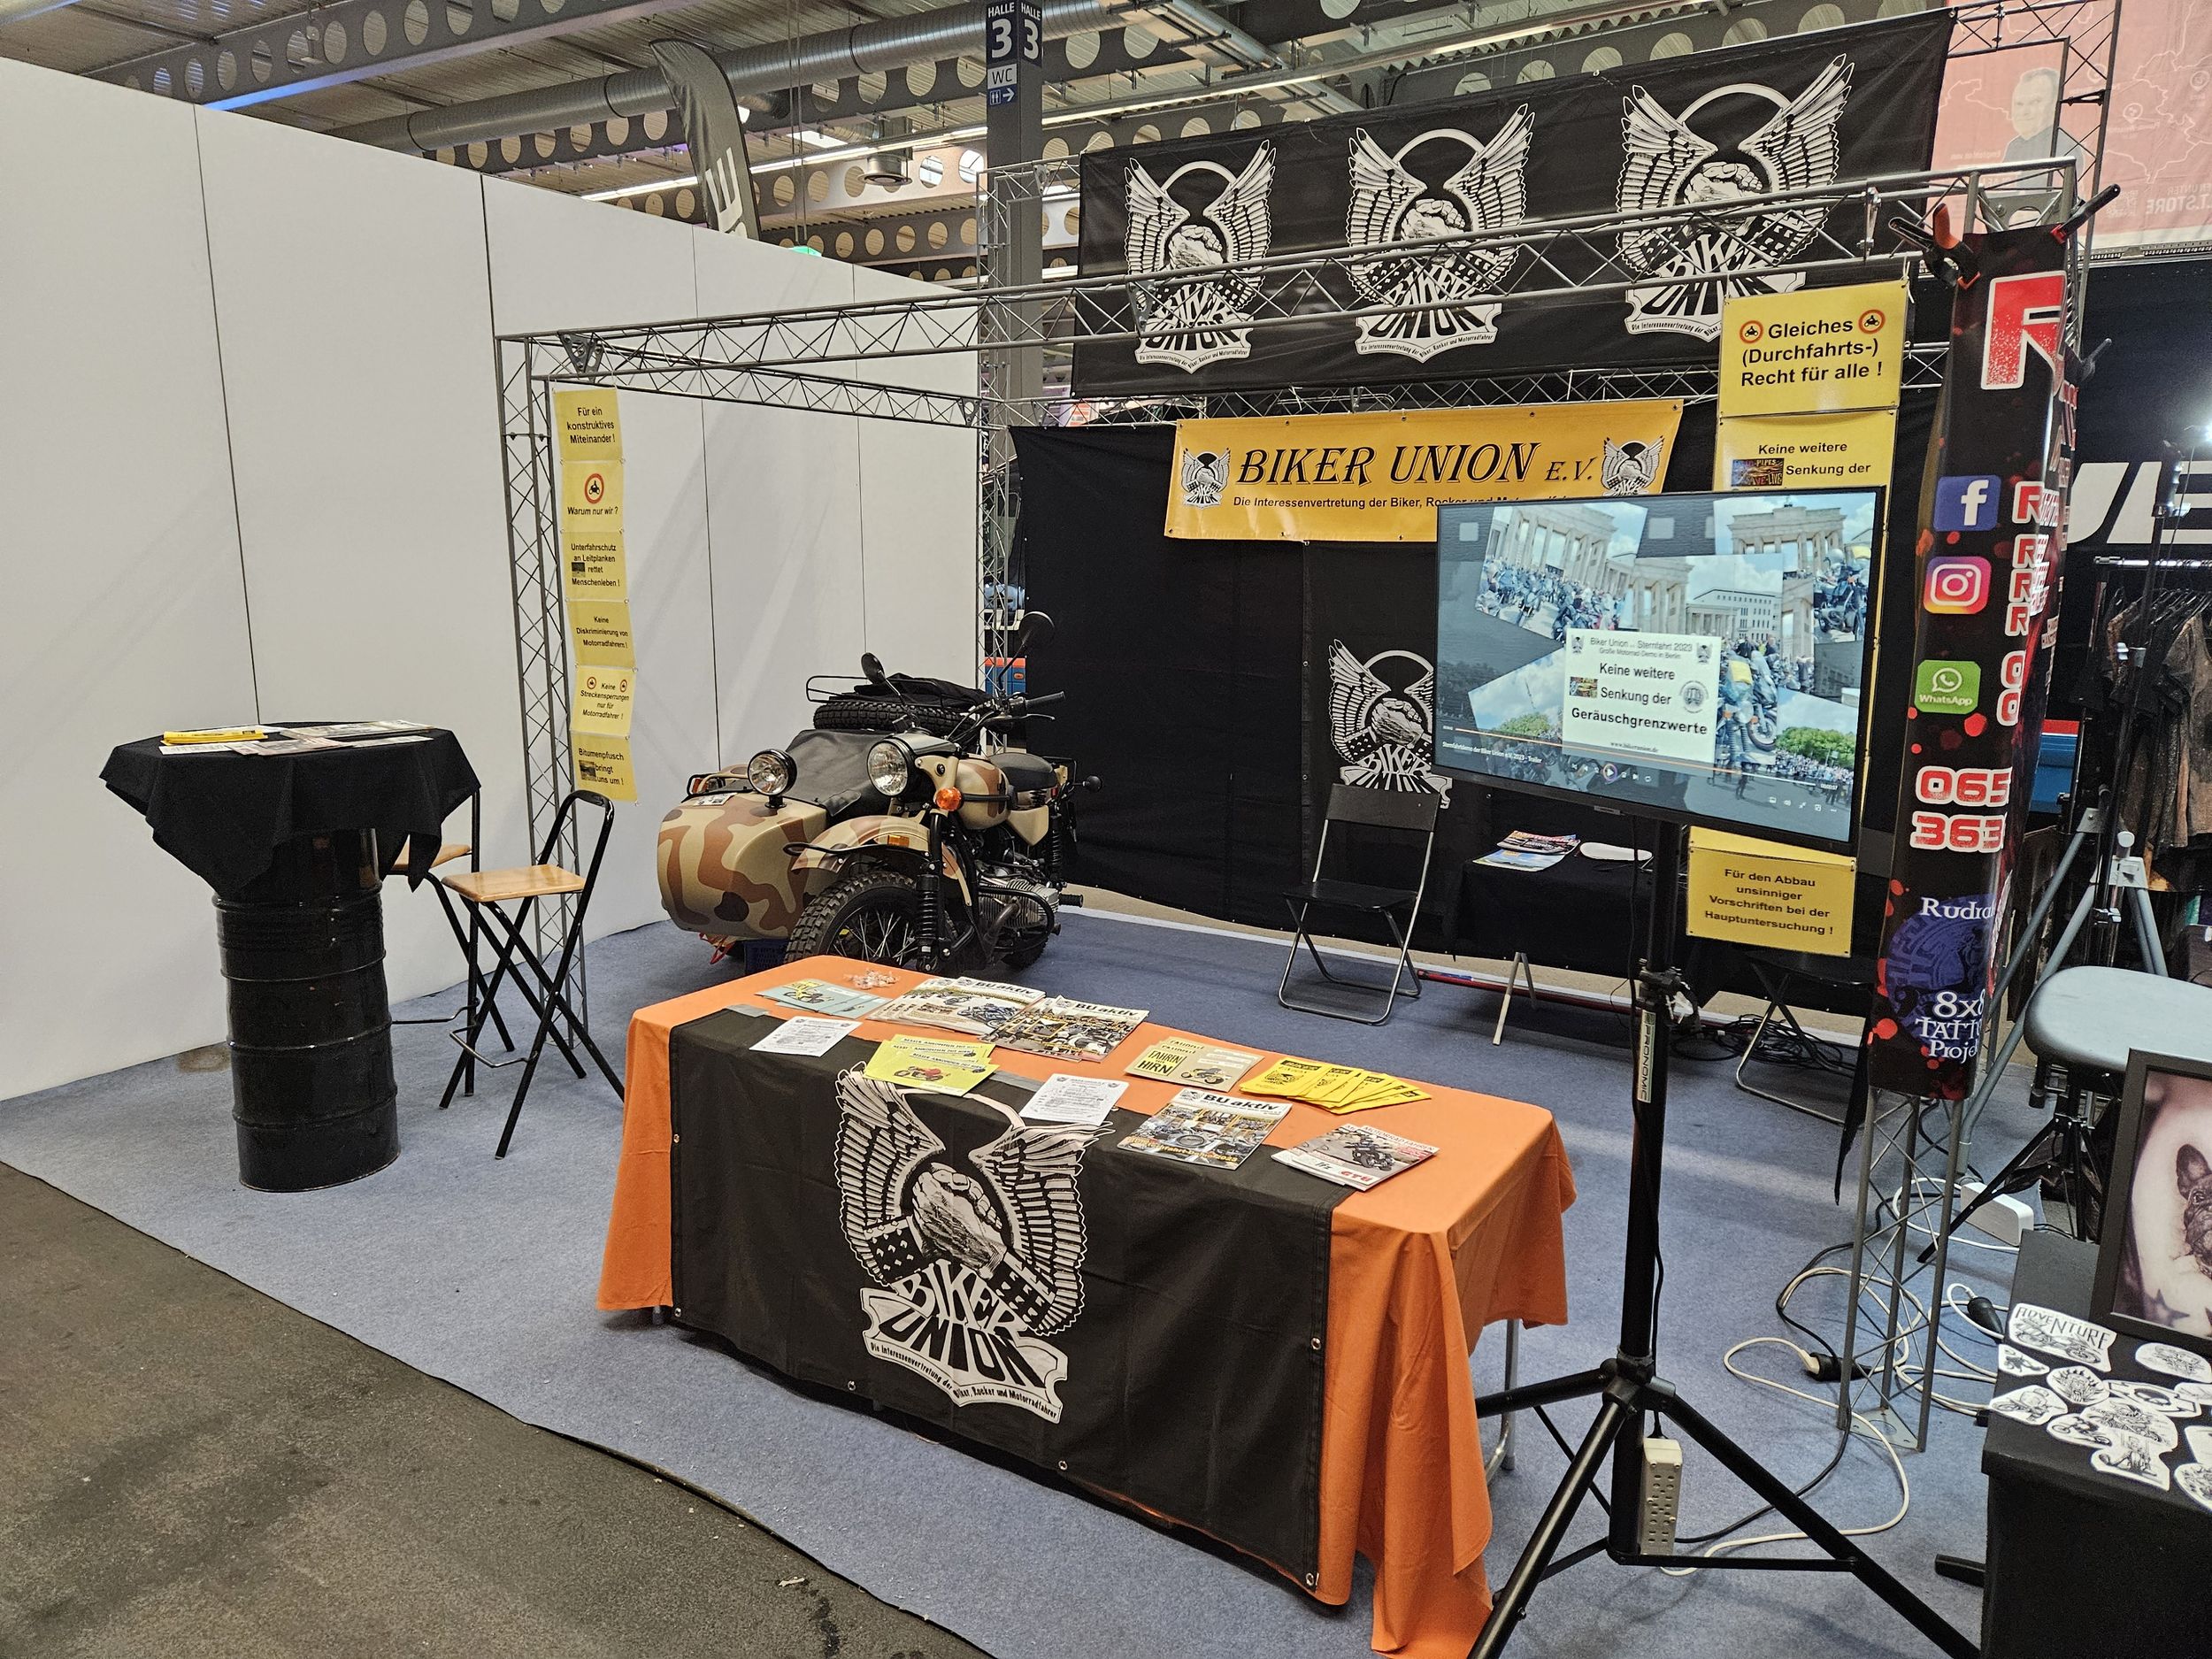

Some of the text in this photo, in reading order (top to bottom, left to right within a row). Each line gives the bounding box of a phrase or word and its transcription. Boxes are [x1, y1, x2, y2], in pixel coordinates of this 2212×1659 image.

[988, 3, 1015, 17] HALLE
[1021, 4, 1041, 20] HALLE
[991, 19, 1012, 58] 3
[1024, 19, 1039, 59] 3
[992, 68, 1012, 82] WC
[1769, 319, 1854, 339] Gleiches
[1742, 338, 1879, 367] (Durchfahrts-)
[1741, 361, 1882, 387] Recht für alle !
[578, 407, 603, 417] Für ein
[566, 421, 615, 431] konstruktives
[570, 434, 612, 444] Miteinander
[1758, 442, 1847, 455] Keine weitere
[1236, 442, 1597, 487] BIKER UNION E.V.
[1786, 463, 1871, 476] Senkung der
[1233, 496, 1250, 506] Die
[1254, 496, 1365, 510] Interessenvertretung
[1369, 497, 1386, 507] der
[1391, 497, 1422, 509] Biker,
[567, 506, 591, 516] Warum
[571, 543, 617, 552] Unterfahrschutz
[582, 554, 615, 564] Leitplanken
[572, 578, 617, 587] Menschenleben
[576, 627, 618, 638] Diskriminierung
[1609, 638, 1629, 647] Union
[1600, 663, 1676, 680] Keine weitere
[580, 689, 630, 702] Streckensperrungen
[1601, 687, 1649, 705] Senkung
[1653, 692, 1672, 705] der
[1919, 694, 1973, 706] WhatsApp
[582, 709, 619, 720] Motorradfahrer
[1571, 707, 1708, 734] Geräuschgrenzwerte
[579, 748, 625, 761] Bitumenpfusch
[1358, 744, 1432, 778] BIKER
[1725, 869, 1816, 887] Für den Abbau
[1736, 887, 1803, 901] unsinniger
[1709, 895, 1831, 918] Vorschriften bei der
[1705, 910, 1825, 935] Hauptuntersuchung
[998, 985, 1034, 995] aktiv
[1148, 1050, 1184, 1064] FAHREN
[1640, 1025, 1653, 1101] PRONOMIC
[1137, 1060, 1173, 1074] HIRN
[1203, 1094, 1230, 1103] BU
[1231, 1102, 1279, 1110] aktiv
[890, 1258, 1027, 1336] BIKER
[2015, 1307, 2110, 1350] ADVENTURE
[879, 1310, 1047, 1388] UNION
[871, 1341, 1057, 1419] Die Interessenvertretung der Biker, Rocker und Motorradfahrer
